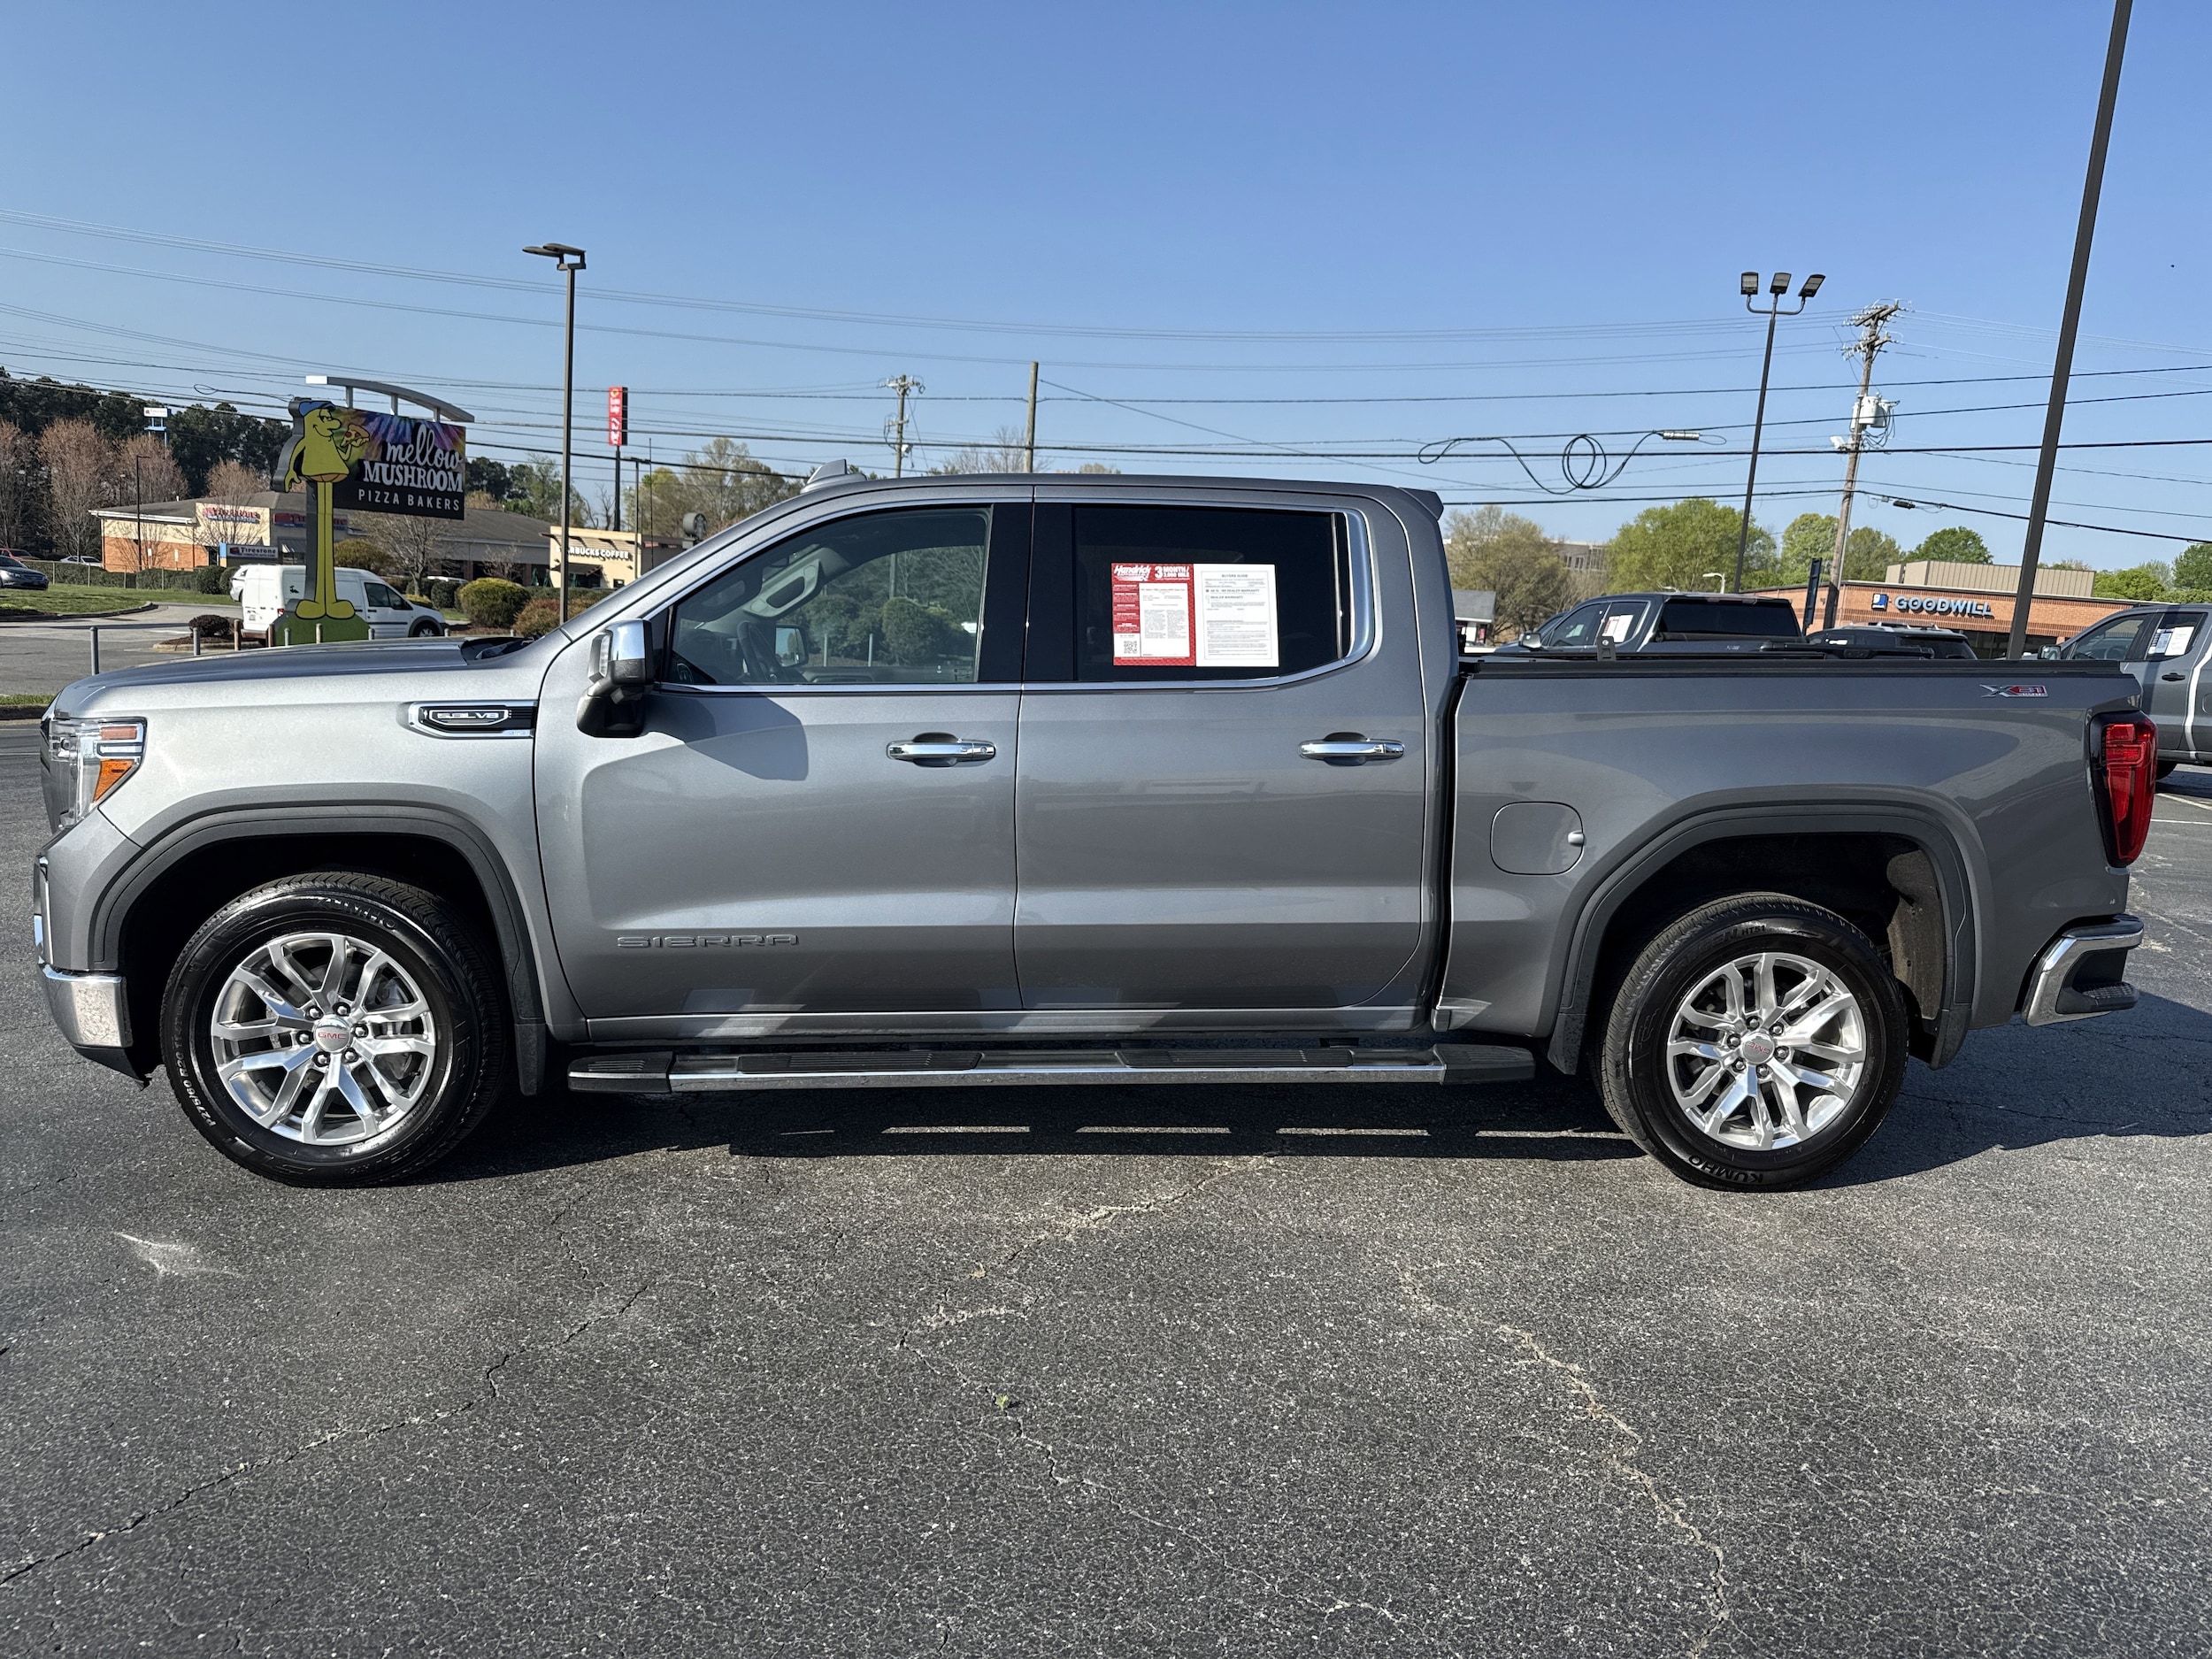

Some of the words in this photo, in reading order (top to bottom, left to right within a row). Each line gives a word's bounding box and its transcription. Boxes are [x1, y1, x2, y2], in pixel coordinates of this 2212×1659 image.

[386, 424, 463, 470] mellow
[363, 460, 464, 493] MUSHROOM
[358, 488, 400, 505] PIZZA
[407, 494, 460, 511] BAKERS
[601, 549, 629, 560] COFFEE
[1155, 565, 1164, 578] 3
[1895, 595, 1993, 618] GOODWILL
[618, 934, 799, 948] SIERRA
[1741, 925, 1765, 935] HT51
[1747, 1041, 1770, 1055] GMC
[183, 1079, 217, 1127] P275/60
[1689, 1155, 1763, 1184] KUMHO
